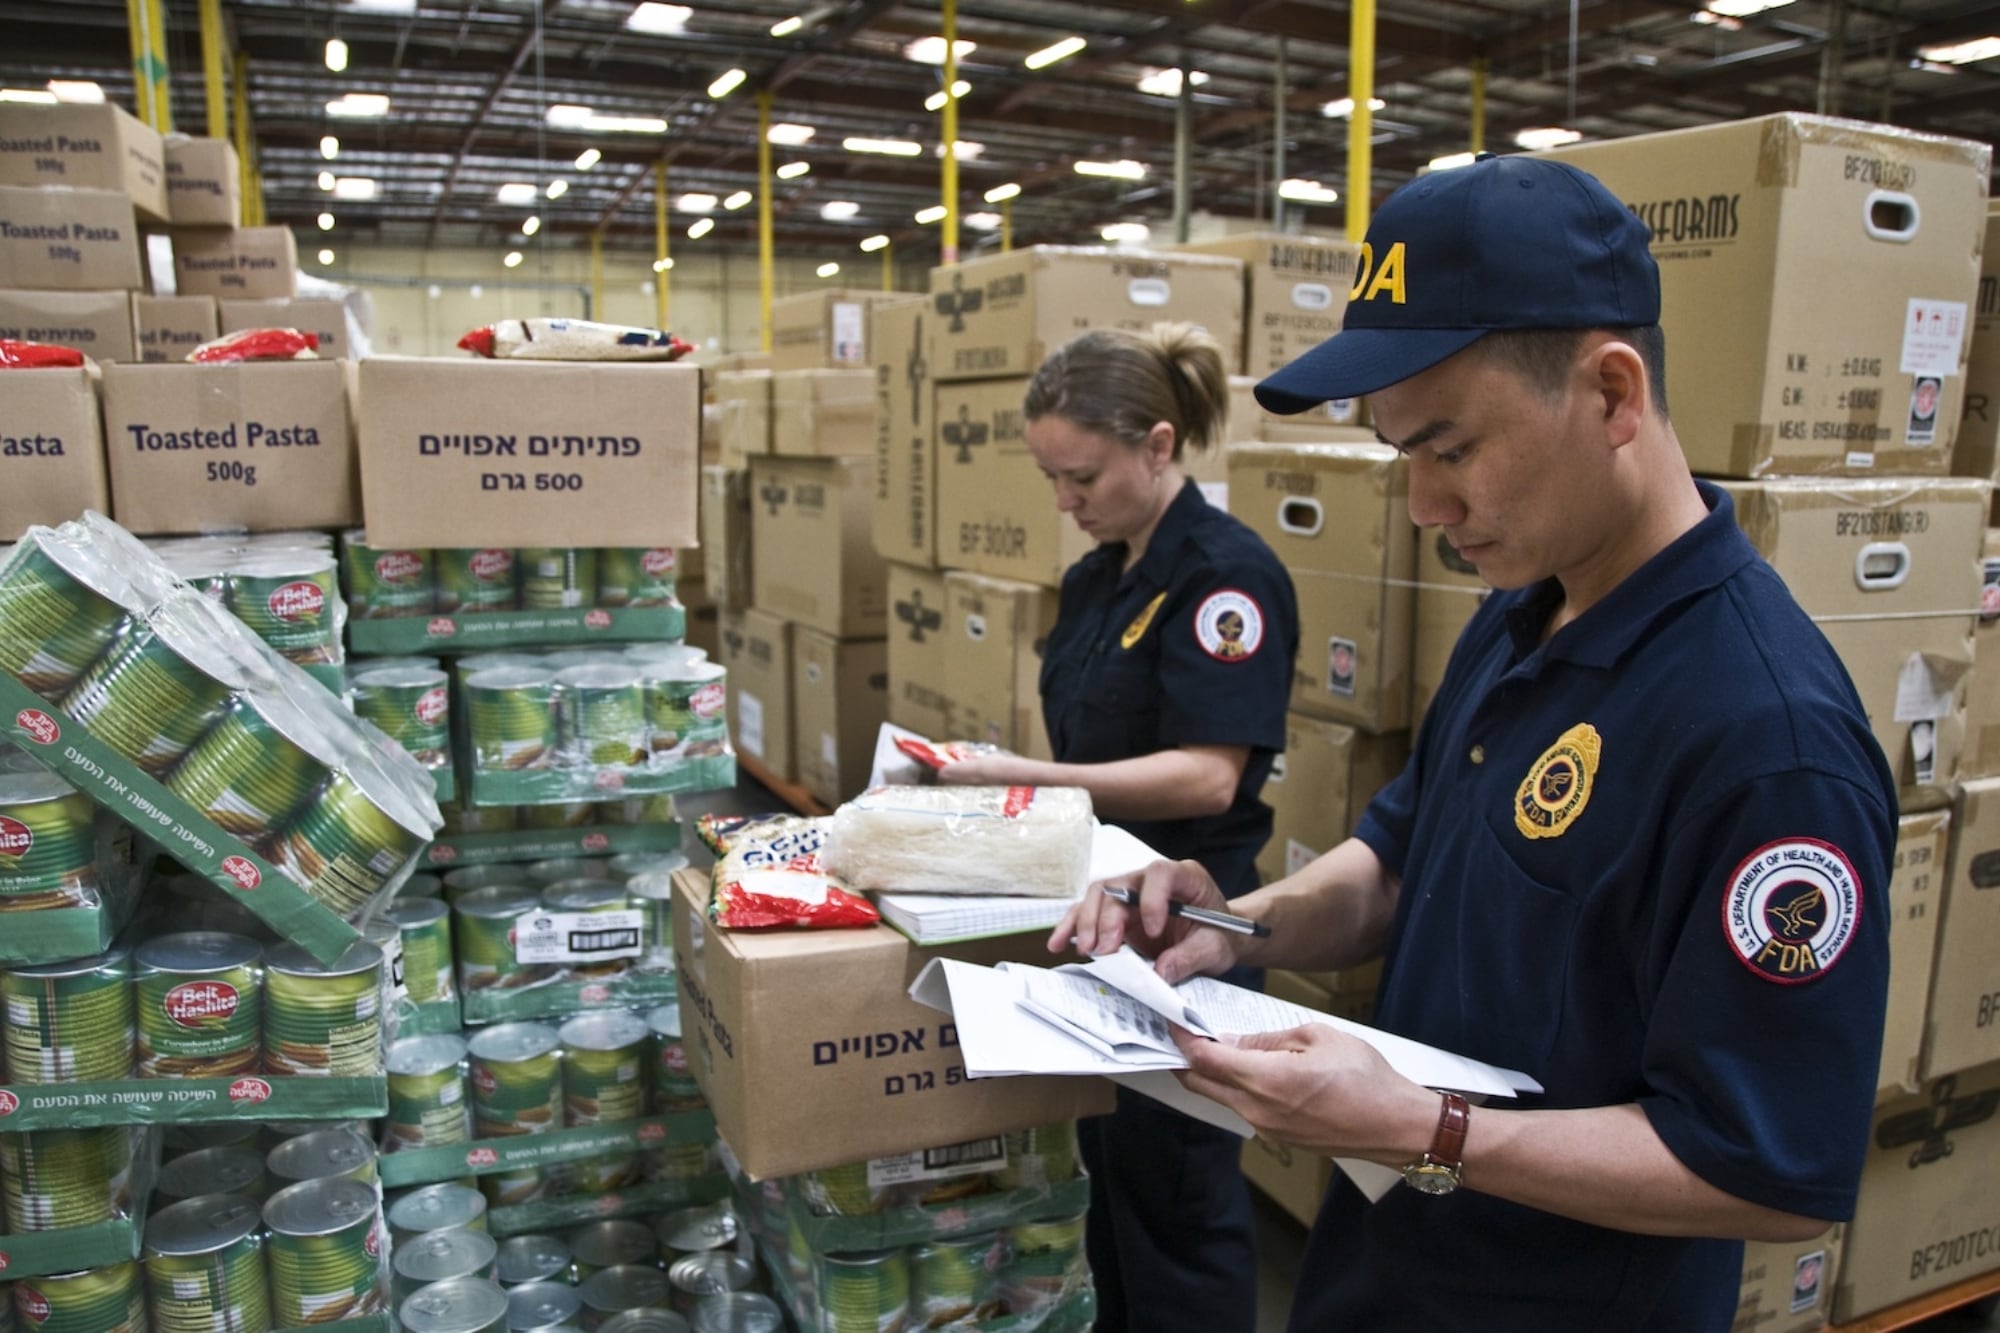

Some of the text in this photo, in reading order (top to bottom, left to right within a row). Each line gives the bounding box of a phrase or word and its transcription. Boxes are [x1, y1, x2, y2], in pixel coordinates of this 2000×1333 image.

[1, 221, 120, 241] Toasted Pasta
[0, 432, 65, 456] asta
[128, 421, 320, 451] Toasted Pasta
[418, 434, 641, 457] פתיתים אפויים
[207, 461, 257, 485] 500g
[481, 473, 583, 491] 500 גרם
[104, 775, 129, 796] את
[127, 791, 173, 826] שעושה
[1525, 800, 1548, 825] FDA
[171, 823, 216, 858] השיטה
[1766, 852, 1781, 867] OF
[1783, 849, 1826, 865] HEALTH
[1824, 859, 1845, 880] AND
[1732, 860, 1767, 927] DEPARTMENT
[1839, 876, 1854, 915] HUMAN
[1819, 916, 1852, 962] SERVICES
[1757, 937, 1817, 974] FDA
[172, 995, 237, 1018] Hashita
[182, 985, 218, 1004] Beit
[813, 1027, 925, 1067] אפויים
[885, 1070, 936, 1097] גרם
[32, 1087, 217, 1109] השיטה שעושה את הטעם
